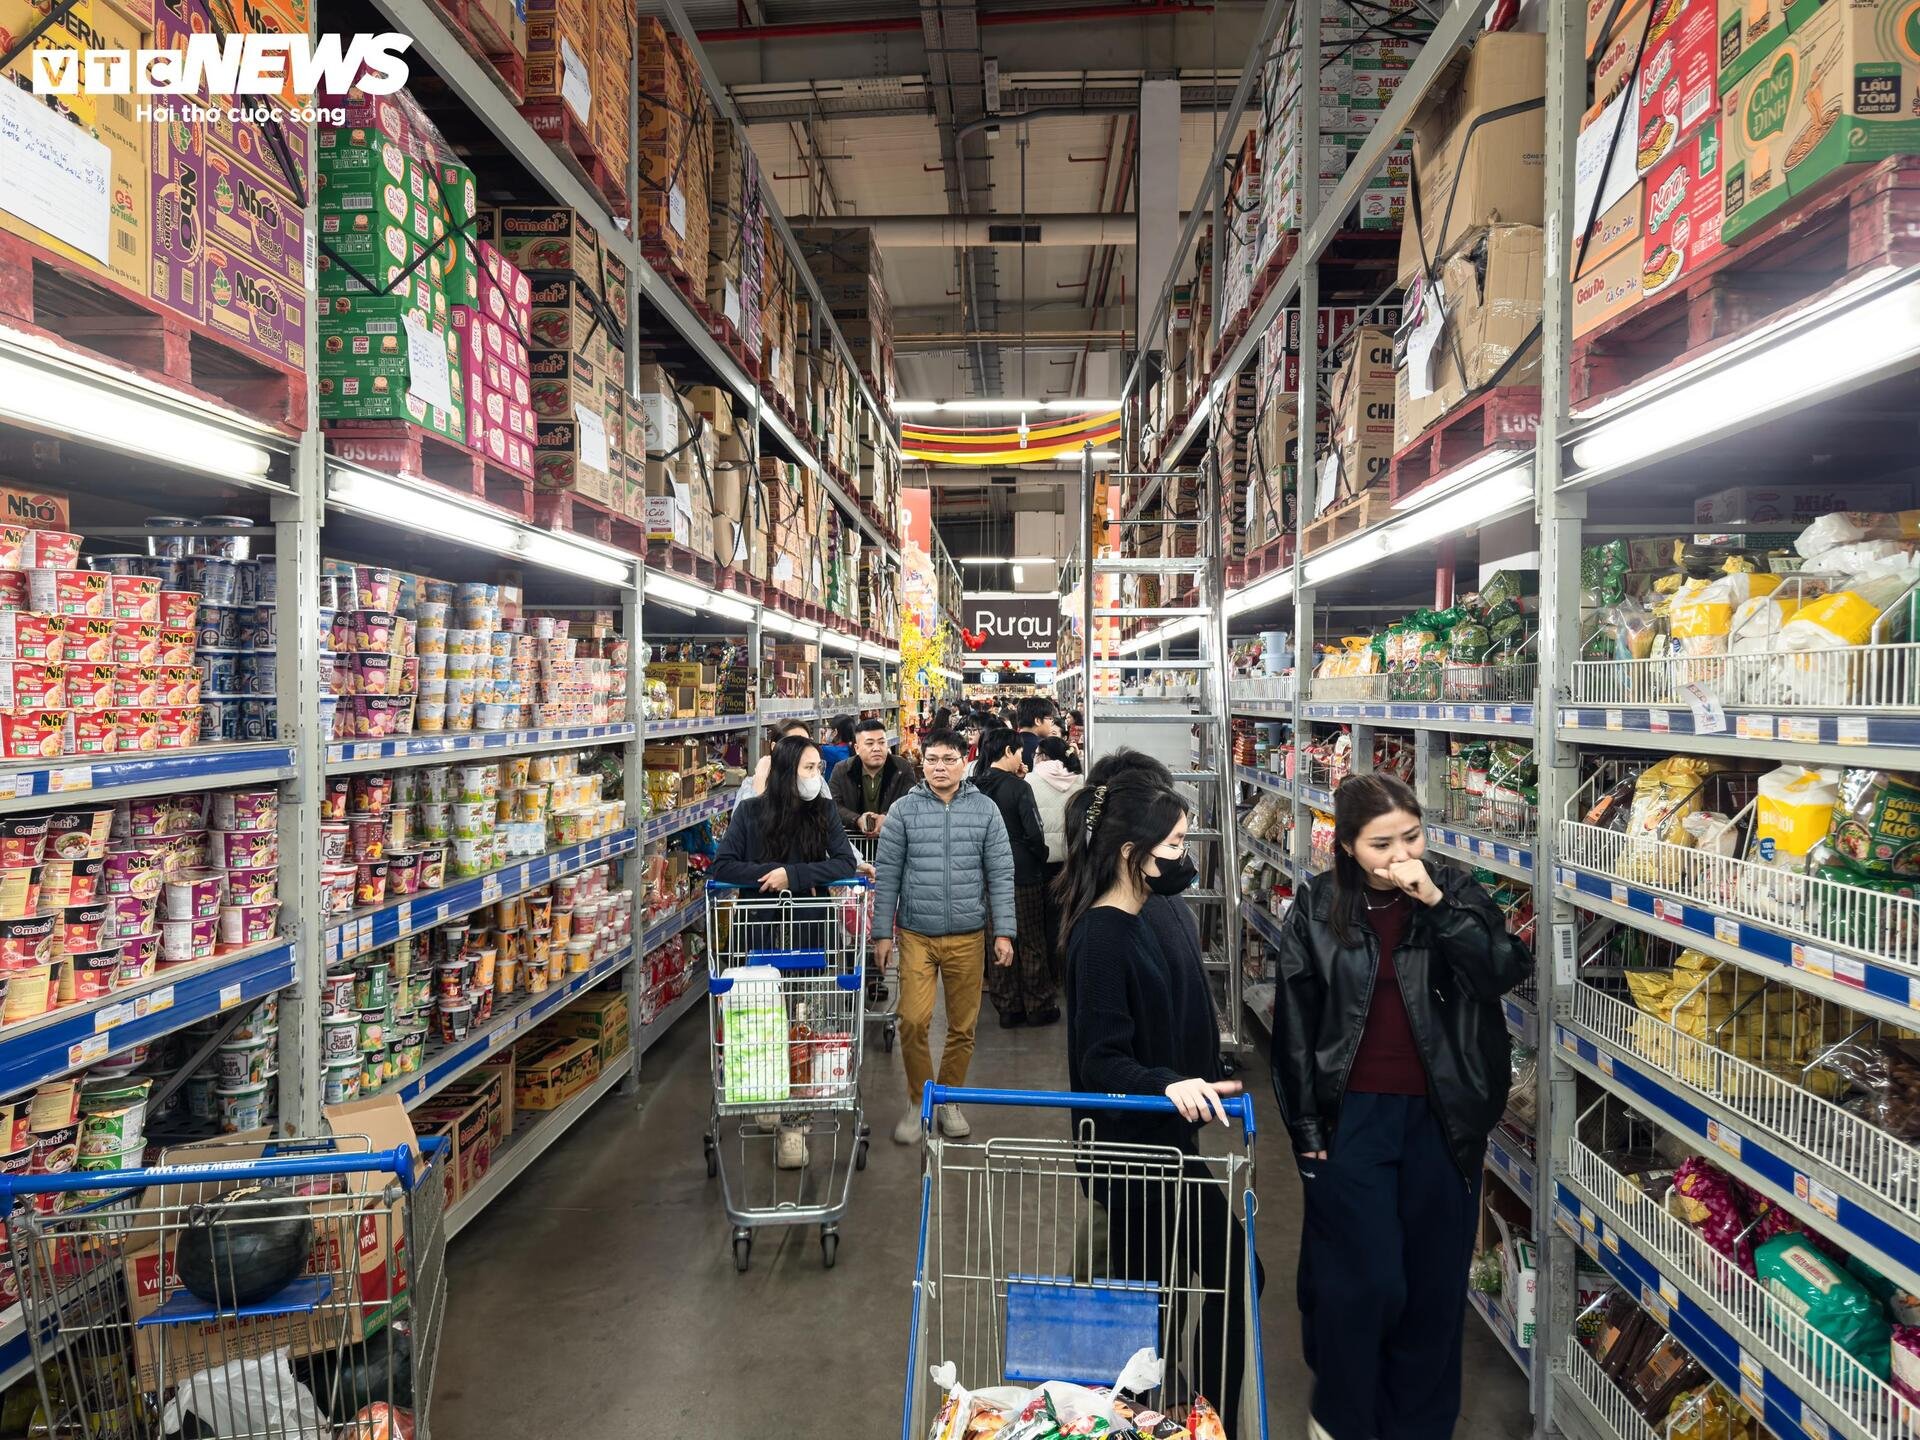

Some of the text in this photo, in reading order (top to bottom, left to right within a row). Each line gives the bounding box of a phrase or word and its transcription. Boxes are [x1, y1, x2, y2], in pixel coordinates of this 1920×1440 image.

[1752, 67, 1790, 112] CUNG
[1861, 77, 1892, 91] LẨU
[1858, 91, 1896, 104] TÔM
[976, 611, 1052, 640] Rượu
[1027, 641, 1051, 650] Liquor
